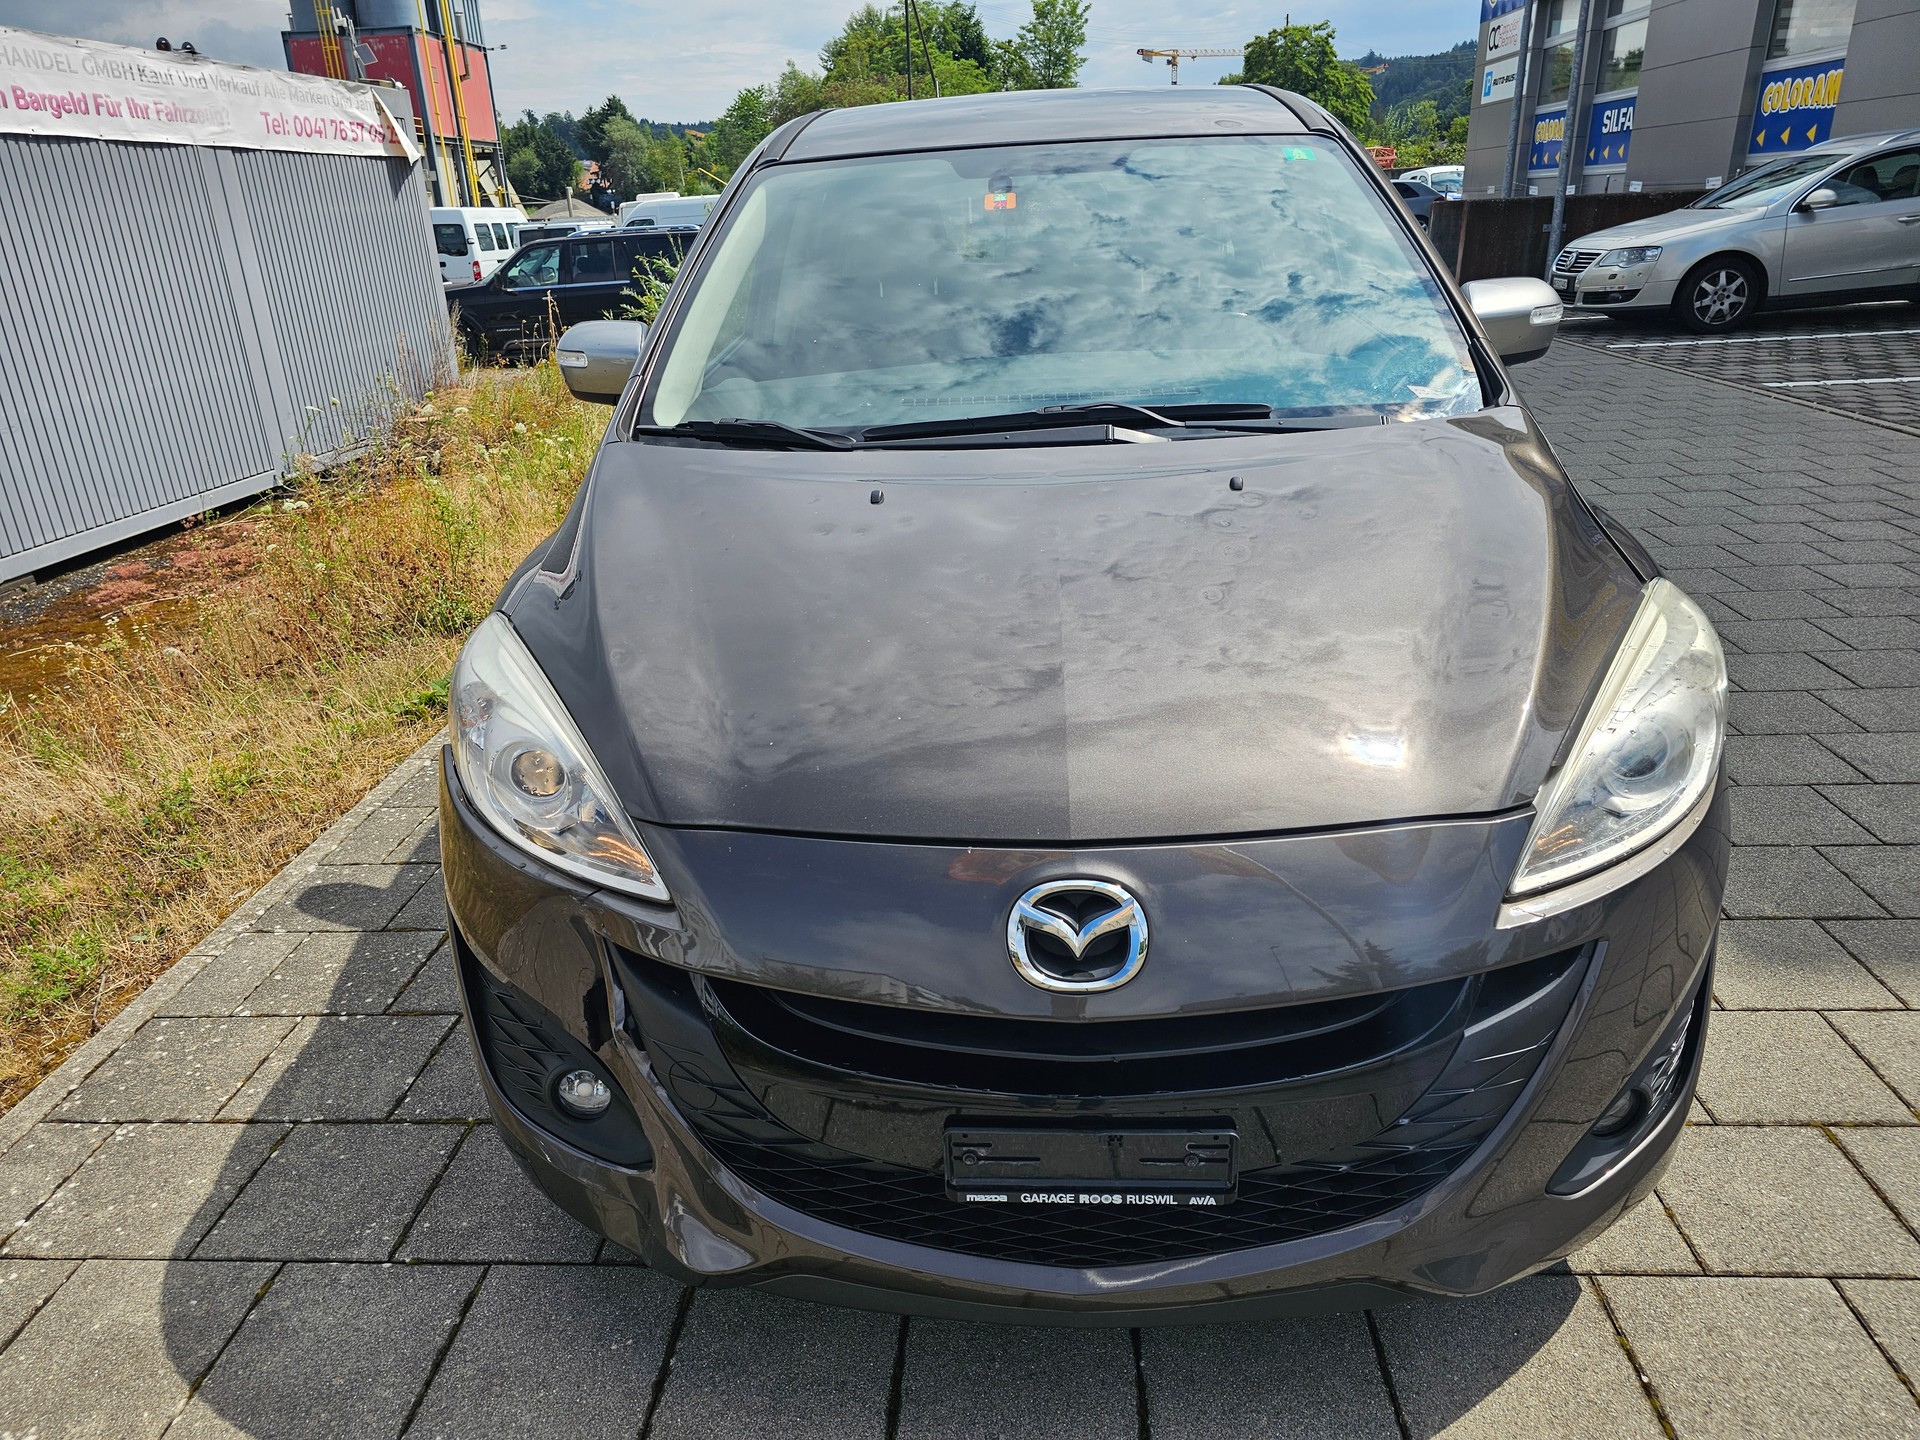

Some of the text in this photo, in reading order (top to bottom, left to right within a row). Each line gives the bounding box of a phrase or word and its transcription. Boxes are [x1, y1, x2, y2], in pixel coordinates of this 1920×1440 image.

[82, 55, 136, 82] GMBH
[137, 64, 175, 86] Kauf
[175, 70, 209, 90] Und
[209, 73, 261, 97] Verkauf
[264, 84, 286, 100] Alle
[289, 88, 331, 106] Marken
[1761, 69, 1844, 117] COLORAM
[11, 84, 90, 119] Bargeld
[92, 92, 124, 118] Für
[125, 96, 150, 120] Ihr
[260, 111, 290, 136] Tel:
[293, 115, 328, 140] 0041
[330, 119, 348, 142] 76
[349, 121, 365, 142] 57
[1535, 116, 1566, 145] COLORA
[1602, 106, 1634, 134] SILFA
[966, 1193, 1217, 1206] mazda GARAGE ROOS RUSWIL AVIA
